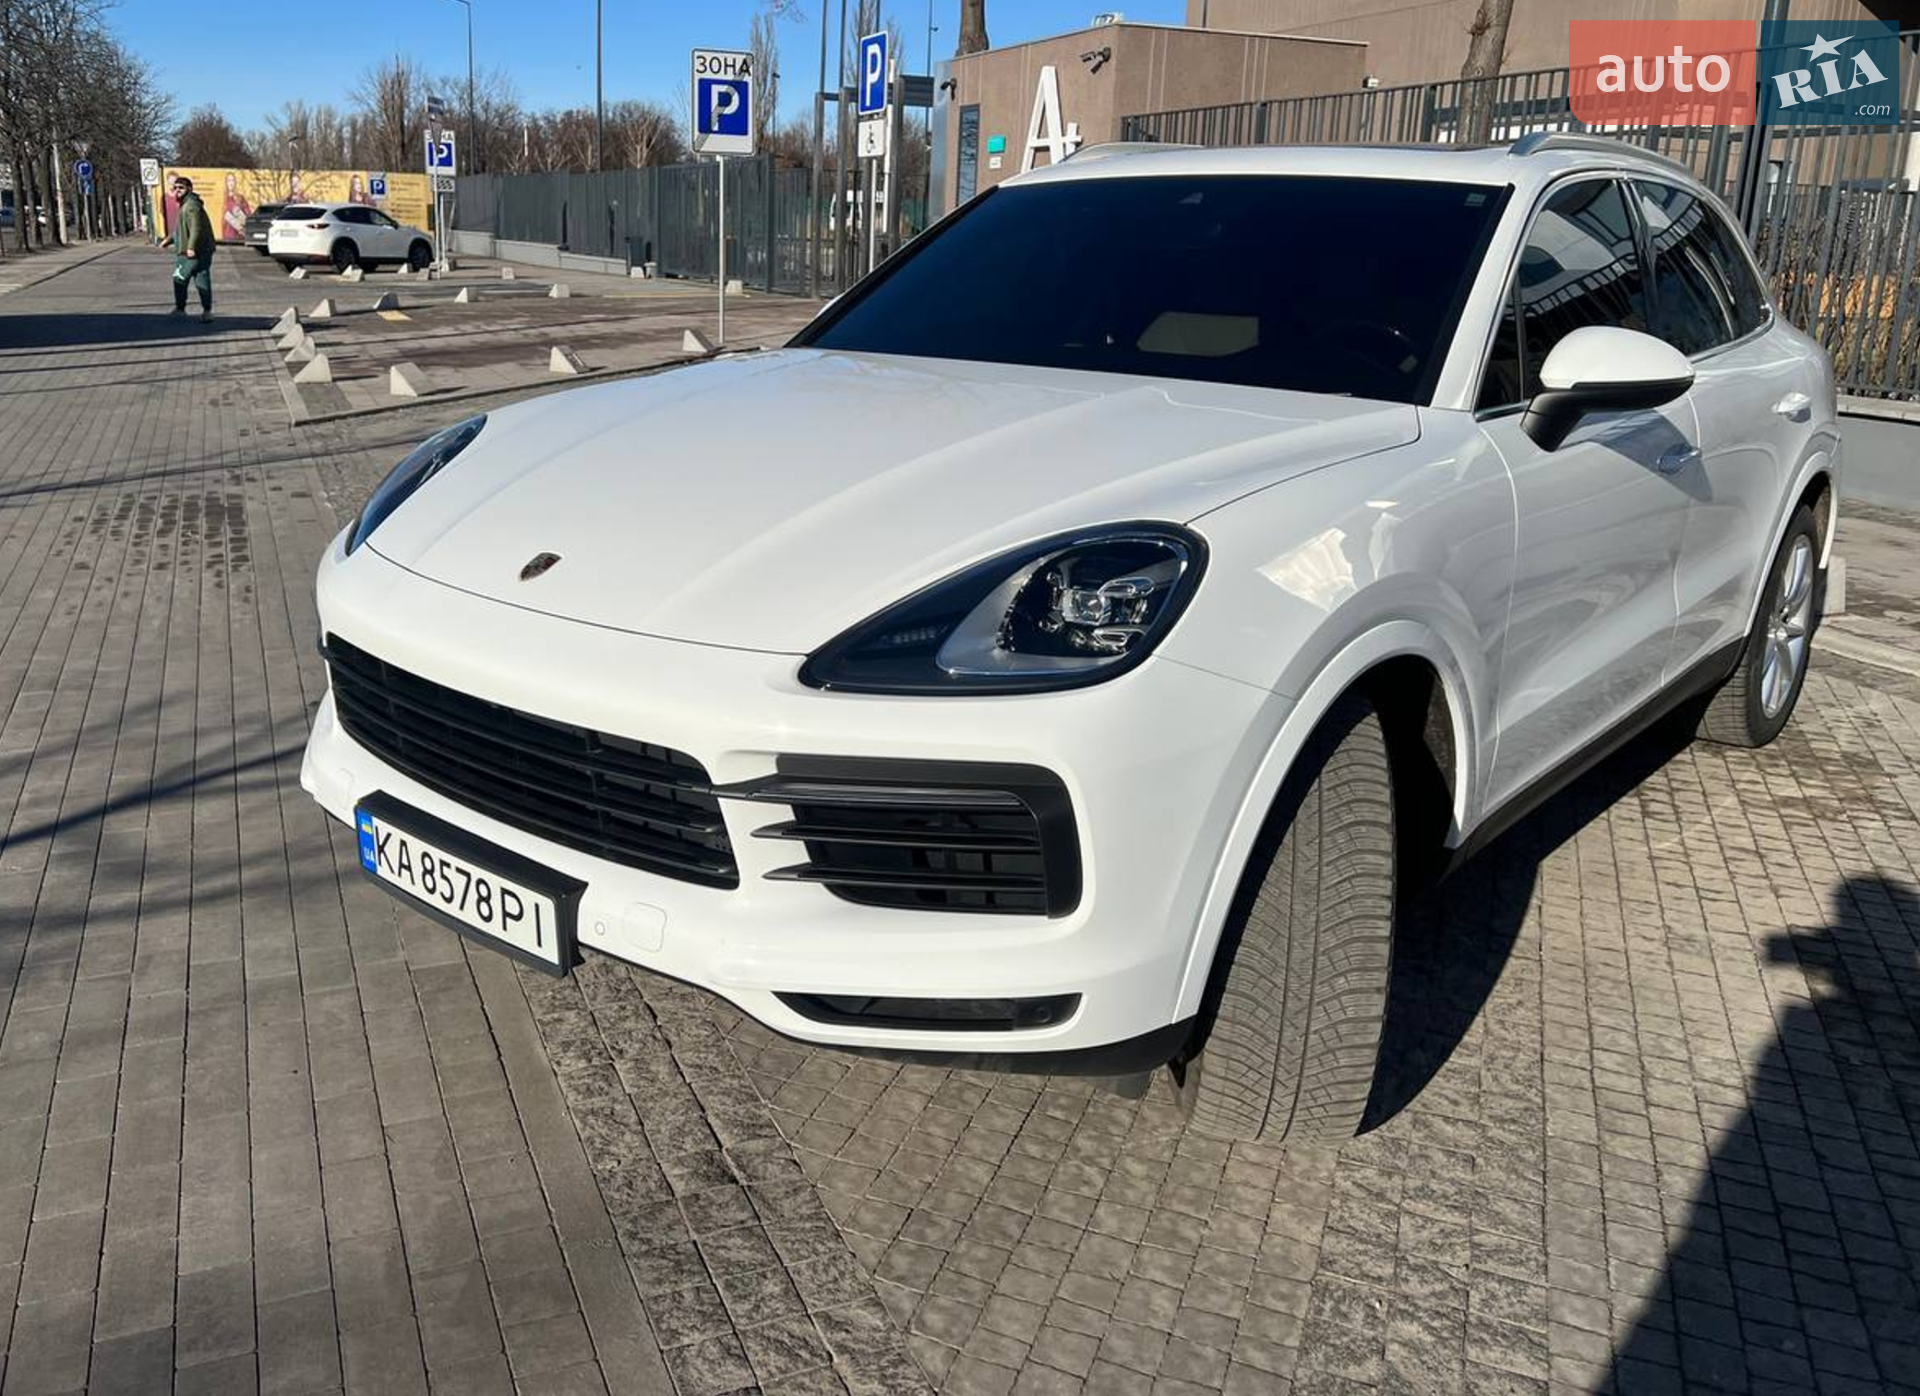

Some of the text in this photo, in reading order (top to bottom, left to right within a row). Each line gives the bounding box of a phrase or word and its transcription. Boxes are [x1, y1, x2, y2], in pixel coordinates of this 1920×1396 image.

[695, 55, 752, 77] ЗОНА
[866, 43, 882, 107] P
[711, 83, 740, 132] P
[375, 825, 416, 886] KA
[420, 851, 494, 924] 8578
